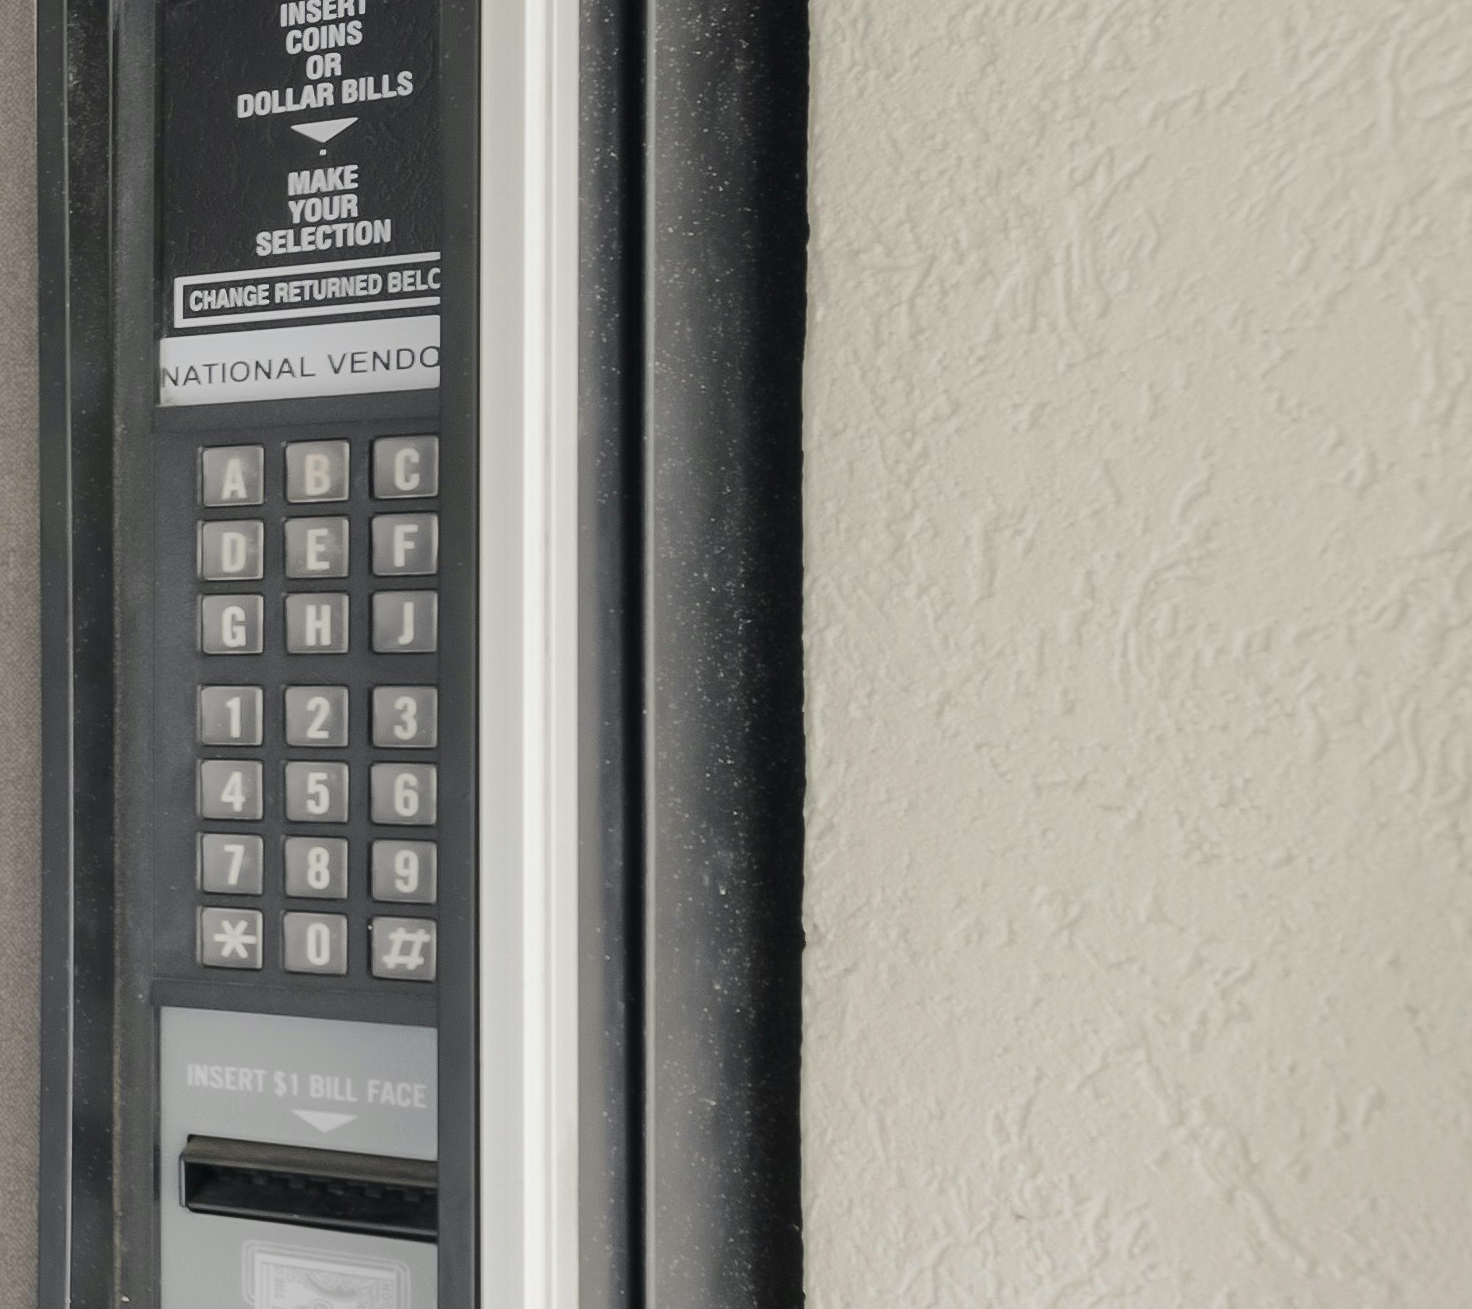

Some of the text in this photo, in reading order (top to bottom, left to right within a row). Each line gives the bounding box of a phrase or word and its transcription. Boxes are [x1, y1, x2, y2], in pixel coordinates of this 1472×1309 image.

[286, 21, 363, 54] COINS
[306, 53, 342, 80] OR
[237, 71, 414, 119] DOLLAR BILLS
[287, 164, 359, 196] MAKE
[288, 193, 358, 224] YOUR
[256, 219, 392, 257] SELECTION
[189, 284, 271, 312] CHANGE
[274, 273, 383, 304] RETURNED
[162, 355, 316, 387] NATIONAL
[221, 448, 420, 501] A B C
[222, 524, 418, 573] D E F
[222, 601, 415, 648] G H J
[226, 696, 418, 740] 1 2 3
[221, 771, 419, 817] 4 5 6
[223, 844, 419, 894] 7 8 9
[306, 922, 431, 971] 0 #
[187, 1063, 427, 1109] INSERT $1 BILL FACE
